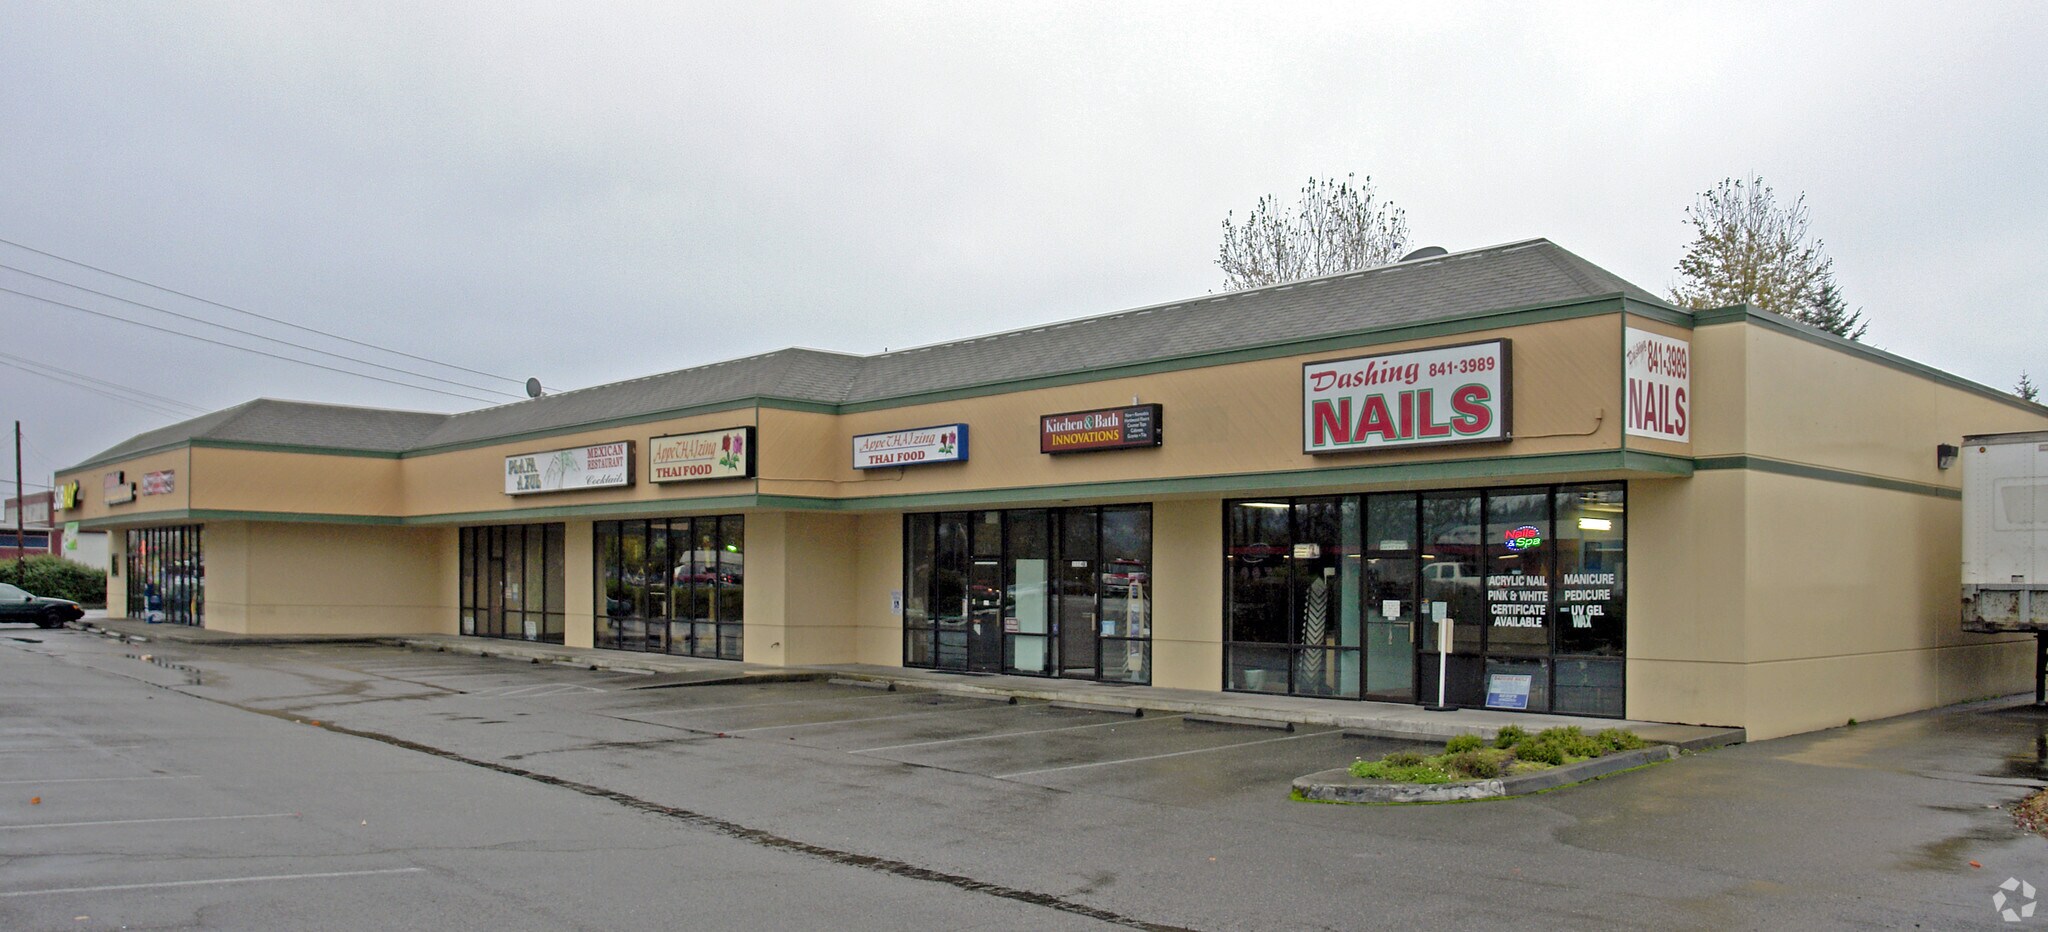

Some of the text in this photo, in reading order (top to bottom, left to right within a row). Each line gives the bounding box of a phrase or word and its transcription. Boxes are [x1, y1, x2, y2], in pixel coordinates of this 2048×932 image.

[1310, 361, 1420, 392] Dashing
[1628, 377, 1686, 437] NAILS
[1312, 382, 1493, 447] NAILS
[1045, 416, 1083, 433] Kitchen
[1084, 415, 1094, 430] &
[1095, 412, 1119, 428] Bath
[1052, 429, 1119, 446] INNOVATIONS
[587, 444, 624, 459] MEXICAN
[869, 450, 926, 464] THAI FOOD
[587, 456, 624, 470] RESTAURANT
[656, 464, 712, 478] THAI FOOD
[585, 473, 624, 486] Cocktails
[1505, 530, 1536, 539] Nails
[1516, 538, 1541, 549] Spa
[1488, 575, 1548, 587] ACRYLIC NAIL
[1564, 573, 1614, 585] MANICURE
[1488, 590, 1548, 602] PINK & WHITE
[1564, 589, 1611, 601] PEDICURE
[1491, 604, 1546, 616] CERTIFICATE
[1571, 605, 1604, 616] UV GEL
[1494, 617, 1542, 628] AVAILABLE
[1572, 615, 1592, 628] WAX
